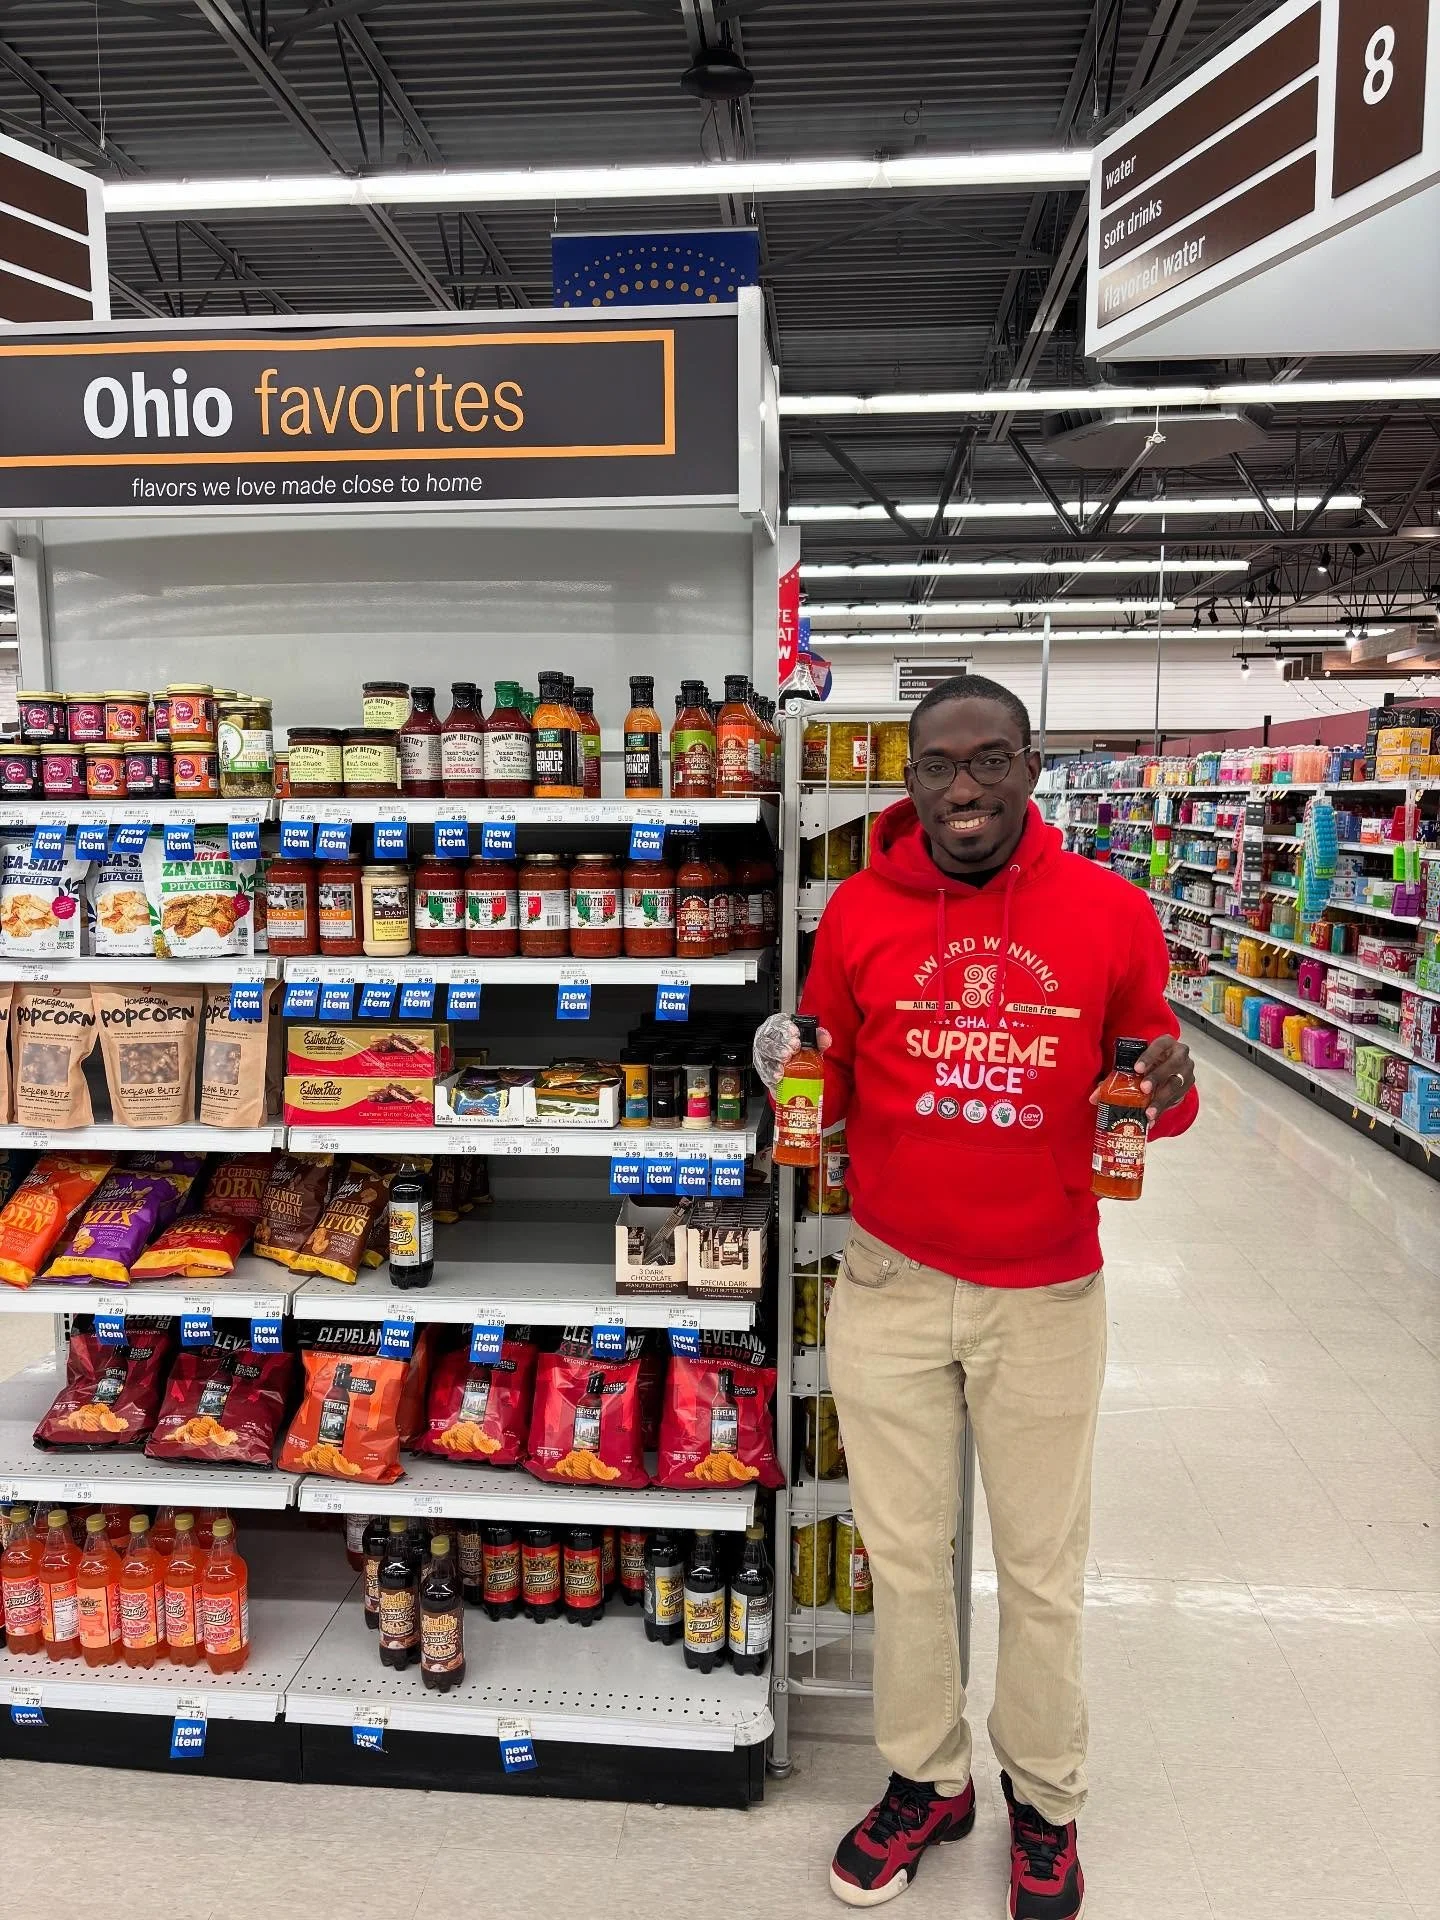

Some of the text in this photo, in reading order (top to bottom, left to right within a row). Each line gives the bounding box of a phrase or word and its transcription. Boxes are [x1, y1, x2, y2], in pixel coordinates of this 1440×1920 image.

[1363, 25, 1395, 105] 8
[1106, 155, 1137, 190] water
[1104, 198, 1162, 250] soft drinks
[1104, 235, 1206, 312] flavored water
[83, 366, 526, 441] Ohio favorites
[131, 471, 482, 500] flavors we love made close to home
[536, 751, 563, 761] GOLDEN
[536, 761, 563, 772] GARLIC
[38, 831, 61, 840] new
[80, 831, 103, 840] new
[168, 831, 189, 840] new
[232, 831, 255, 839] new
[285, 828, 308, 837] new
[322, 831, 345, 839] new
[439, 828, 463, 836] new
[487, 829, 510, 838] new
[636, 831, 659, 839] new
[117, 835, 143, 844] item
[284, 837, 309, 847] item
[319, 839, 346, 849] item
[377, 837, 403, 847] item
[438, 837, 465, 847] item
[485, 839, 512, 848] item
[633, 839, 659, 849] item
[35, 841, 61, 850] item
[78, 841, 104, 850] item
[167, 841, 191, 850] item
[232, 840, 257, 849] item
[163, 862, 233, 875] ZA'ATAR
[24, 876, 53, 885] CHIPS
[169, 881, 230, 890] PITA CHIPS
[984, 936, 1059, 993] WNNING
[235, 991, 258, 999] new
[290, 989, 313, 998] new
[453, 991, 476, 999] new
[234, 999, 259, 1009] item
[287, 997, 313, 1007] item
[323, 1000, 349, 1009] item
[363, 998, 390, 1007] item
[403, 998, 430, 1007] item
[451, 999, 476, 1008] item
[561, 1001, 587, 1010] item
[659, 1000, 685, 1011] item
[1013, 1004, 1056, 1014] Gluten Free
[17, 1007, 95, 1027] POPCORN
[101, 1006, 194, 1027] POPCORN
[955, 1016, 1008, 1029] GHAA
[906, 1029, 1059, 1067] SUPREME
[936, 1062, 1024, 1094] SAUCE
[300, 1081, 342, 1095] Esther Price
[1115, 1150, 1138, 1158] SAUCE
[681, 1166, 704, 1174] new
[614, 1174, 639, 1183] item
[647, 1174, 672, 1183] item
[679, 1175, 705, 1185] item
[715, 1176, 740, 1185] item
[83, 1210, 138, 1227] MIX
[99, 1329, 123, 1338] item
[184, 1329, 210, 1337] item
[317, 1327, 382, 1345] CLEVELAN
[387, 1328, 409, 1336] new
[254, 1335, 279, 1343] item
[384, 1337, 409, 1347] item
[673, 1335, 694, 1343] new
[474, 1342, 499, 1352] item
[596, 1341, 621, 1349] item
[673, 1344, 696, 1352] item
[178, 1726, 201, 1735] new
[175, 1735, 201, 1746] item
[506, 1745, 529, 1754] new
[506, 1753, 532, 1764] item
